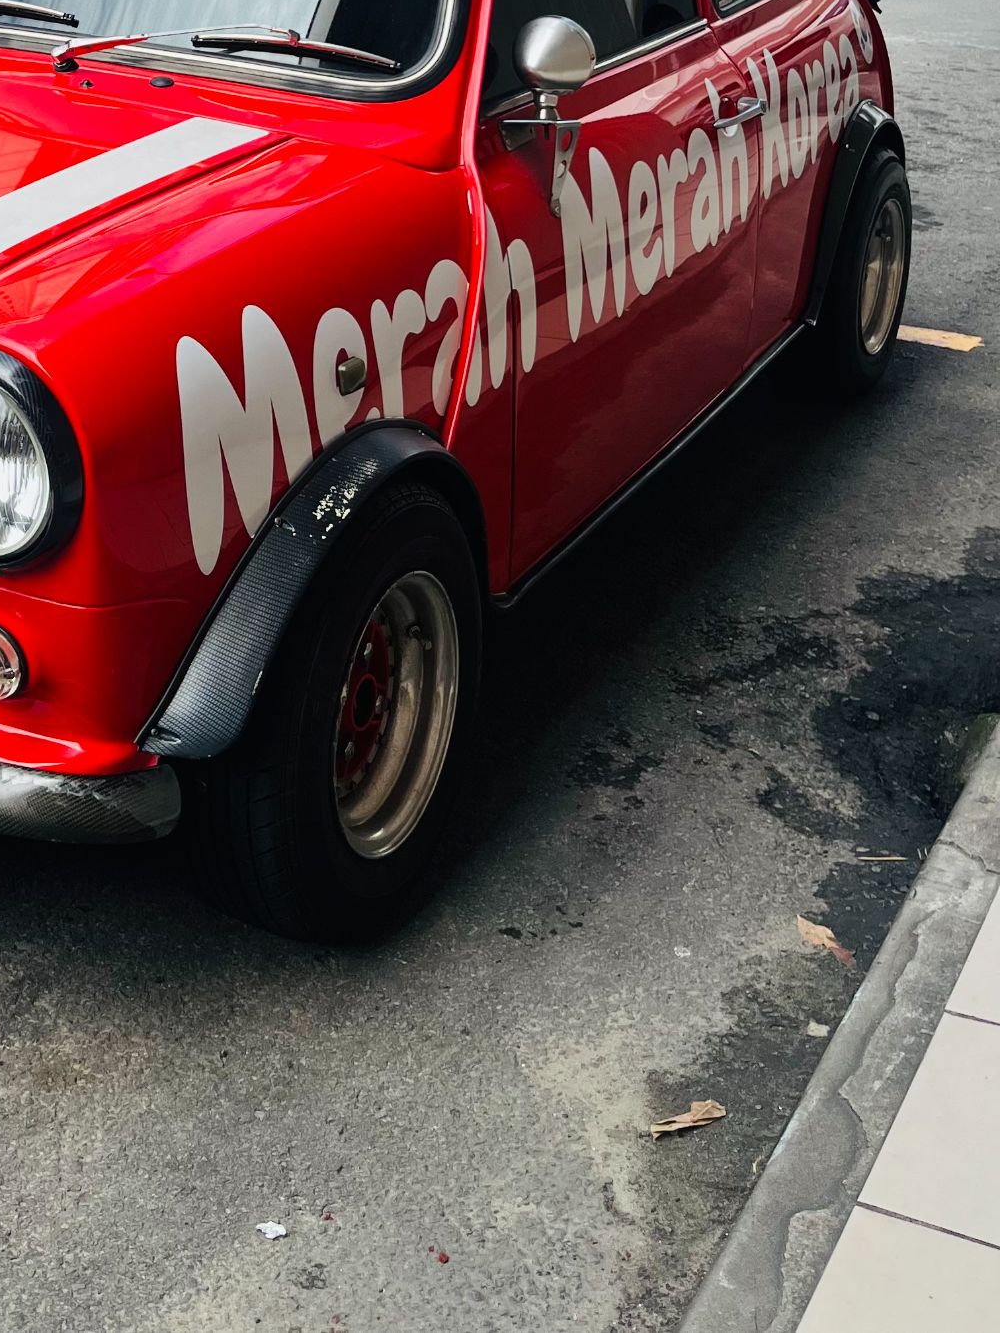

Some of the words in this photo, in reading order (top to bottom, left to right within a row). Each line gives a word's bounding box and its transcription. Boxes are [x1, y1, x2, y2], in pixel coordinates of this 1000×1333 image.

[175, 204, 537, 576] Merah
[561, 77, 749, 344] Merah
[746, 33, 861, 200] Korea
